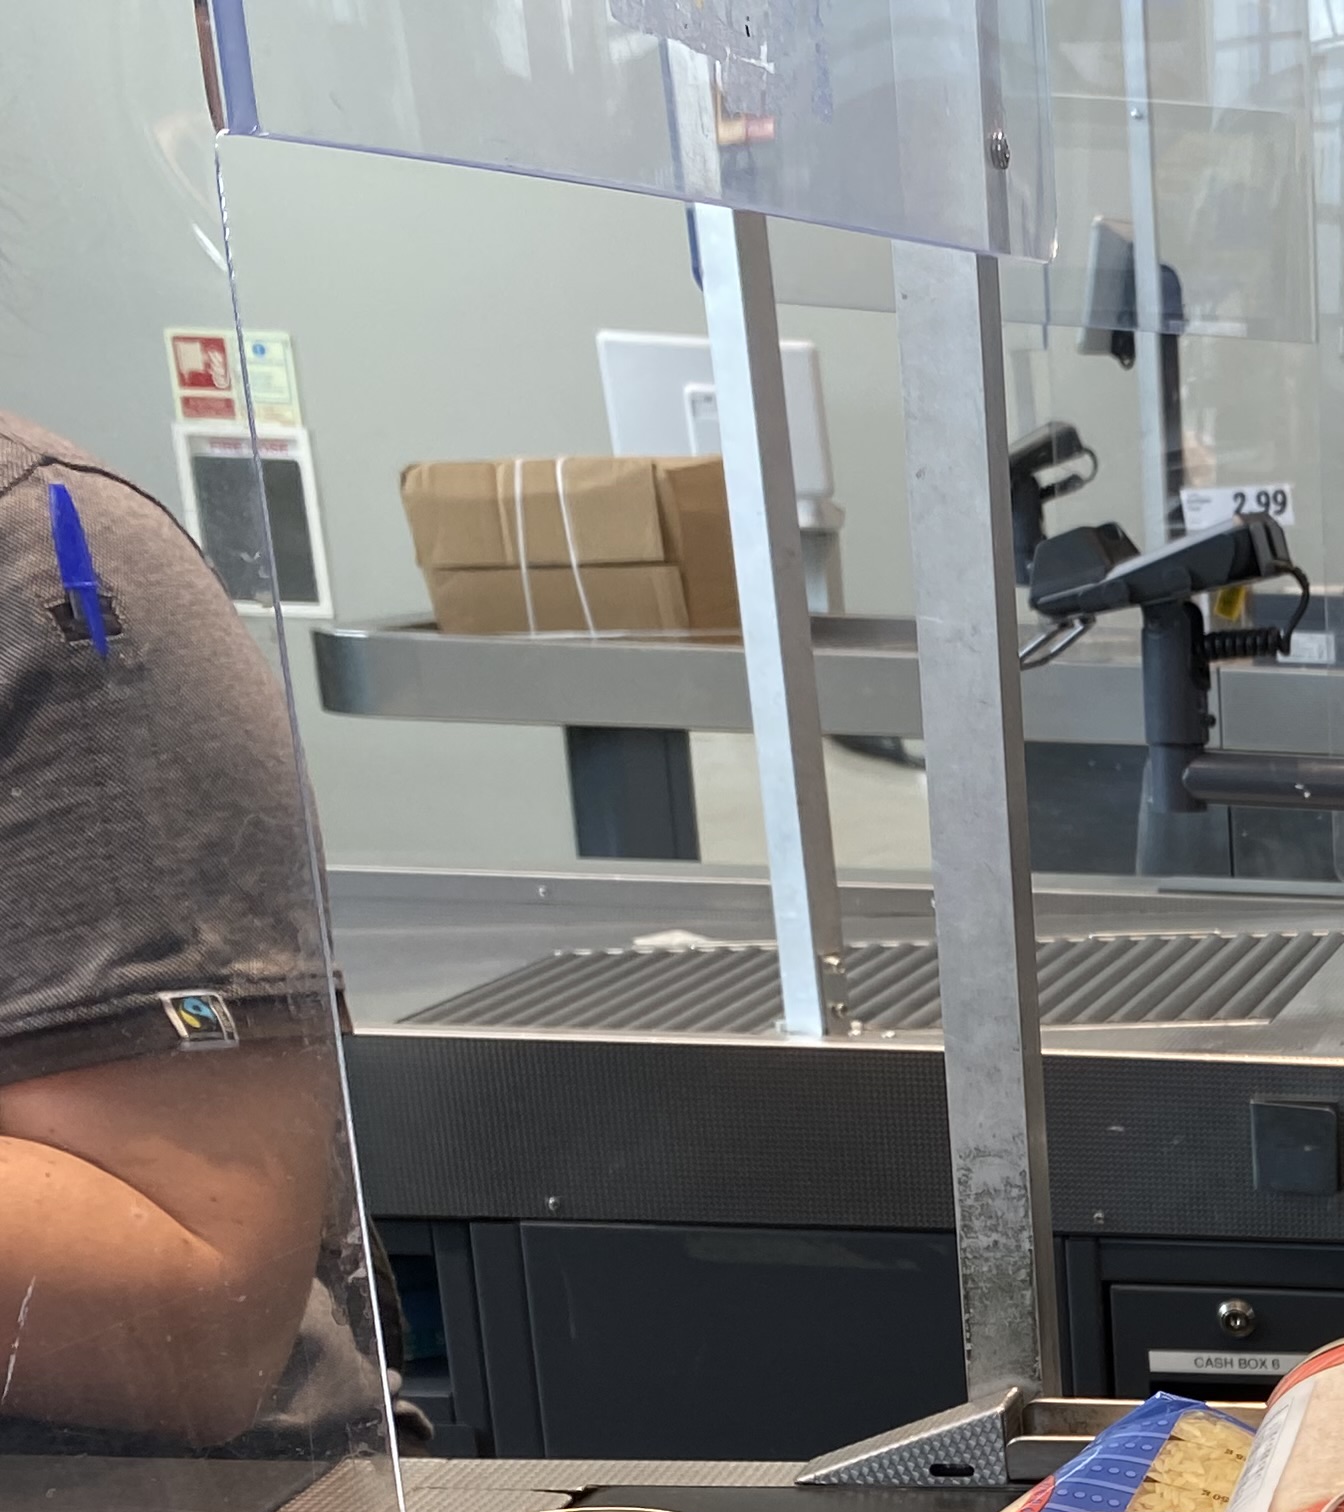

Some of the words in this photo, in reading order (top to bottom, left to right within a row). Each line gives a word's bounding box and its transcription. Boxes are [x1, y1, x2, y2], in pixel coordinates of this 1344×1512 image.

[1233, 489, 1287, 515] 299
[1194, 1357, 1233, 1368] CASH
[1238, 1358, 1267, 1369] BOX
[1272, 1359, 1280, 1369] 6
